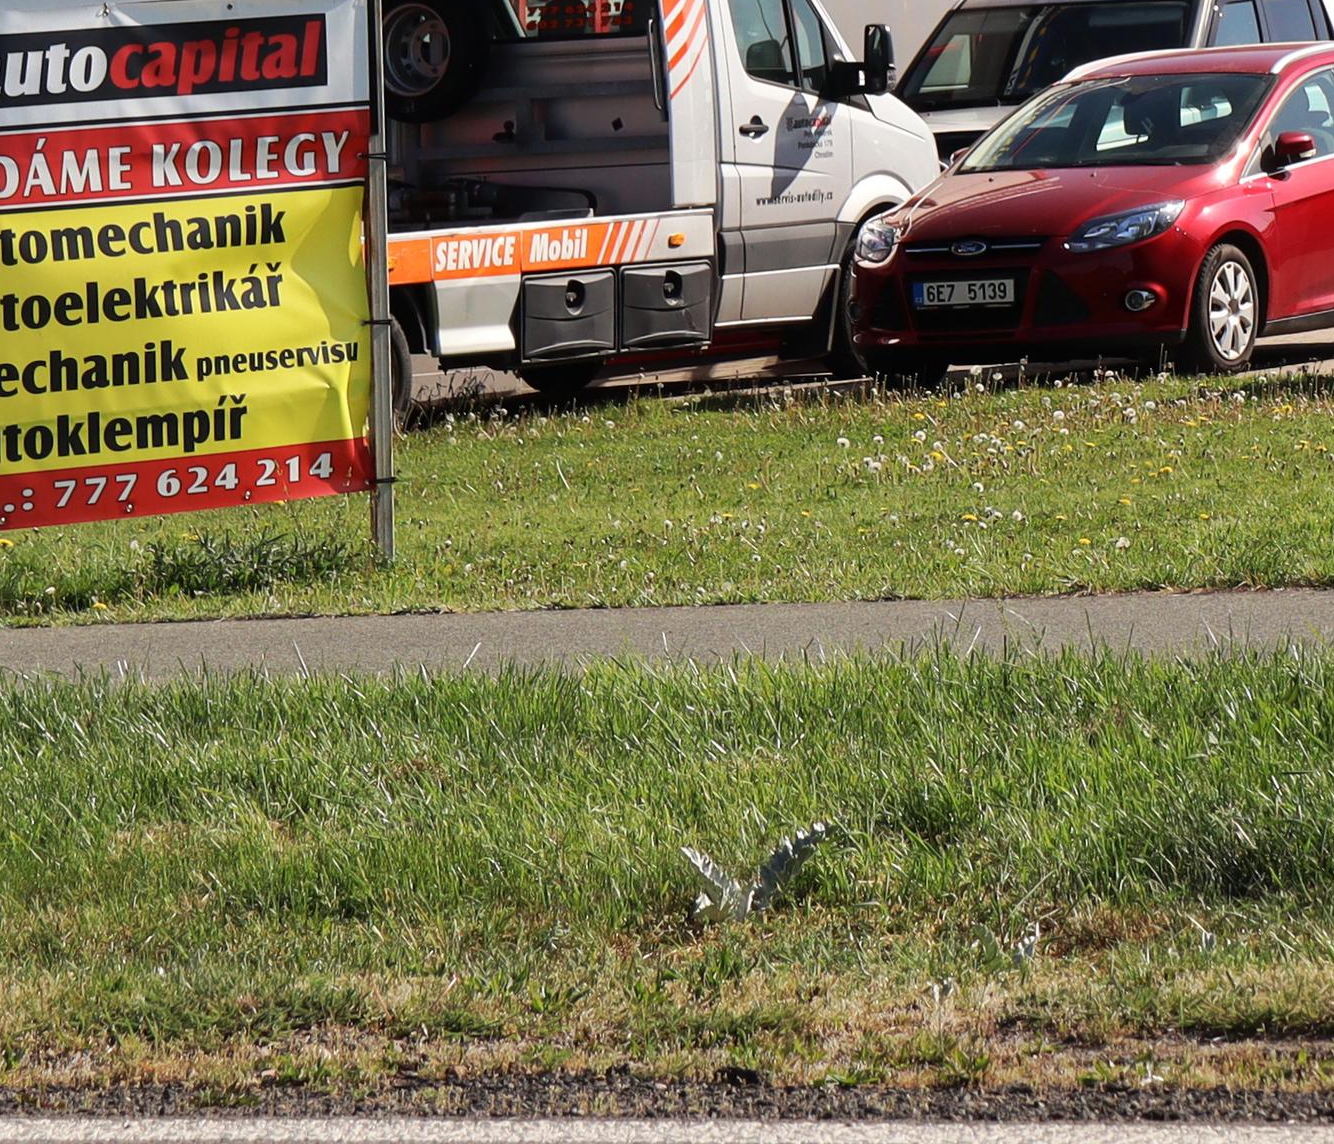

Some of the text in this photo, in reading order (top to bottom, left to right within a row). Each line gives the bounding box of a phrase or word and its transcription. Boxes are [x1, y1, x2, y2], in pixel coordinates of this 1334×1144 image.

[152, 130, 350, 186] KOLEGY
[436, 227, 588, 272] SERVICE Mobil
[927, 282, 1007, 302] 6E7 5139
[196, 341, 359, 383] pneuservisu
[54, 473, 139, 509] 777
[156, 463, 238, 498] 624
[256, 453, 334, 487] 214
